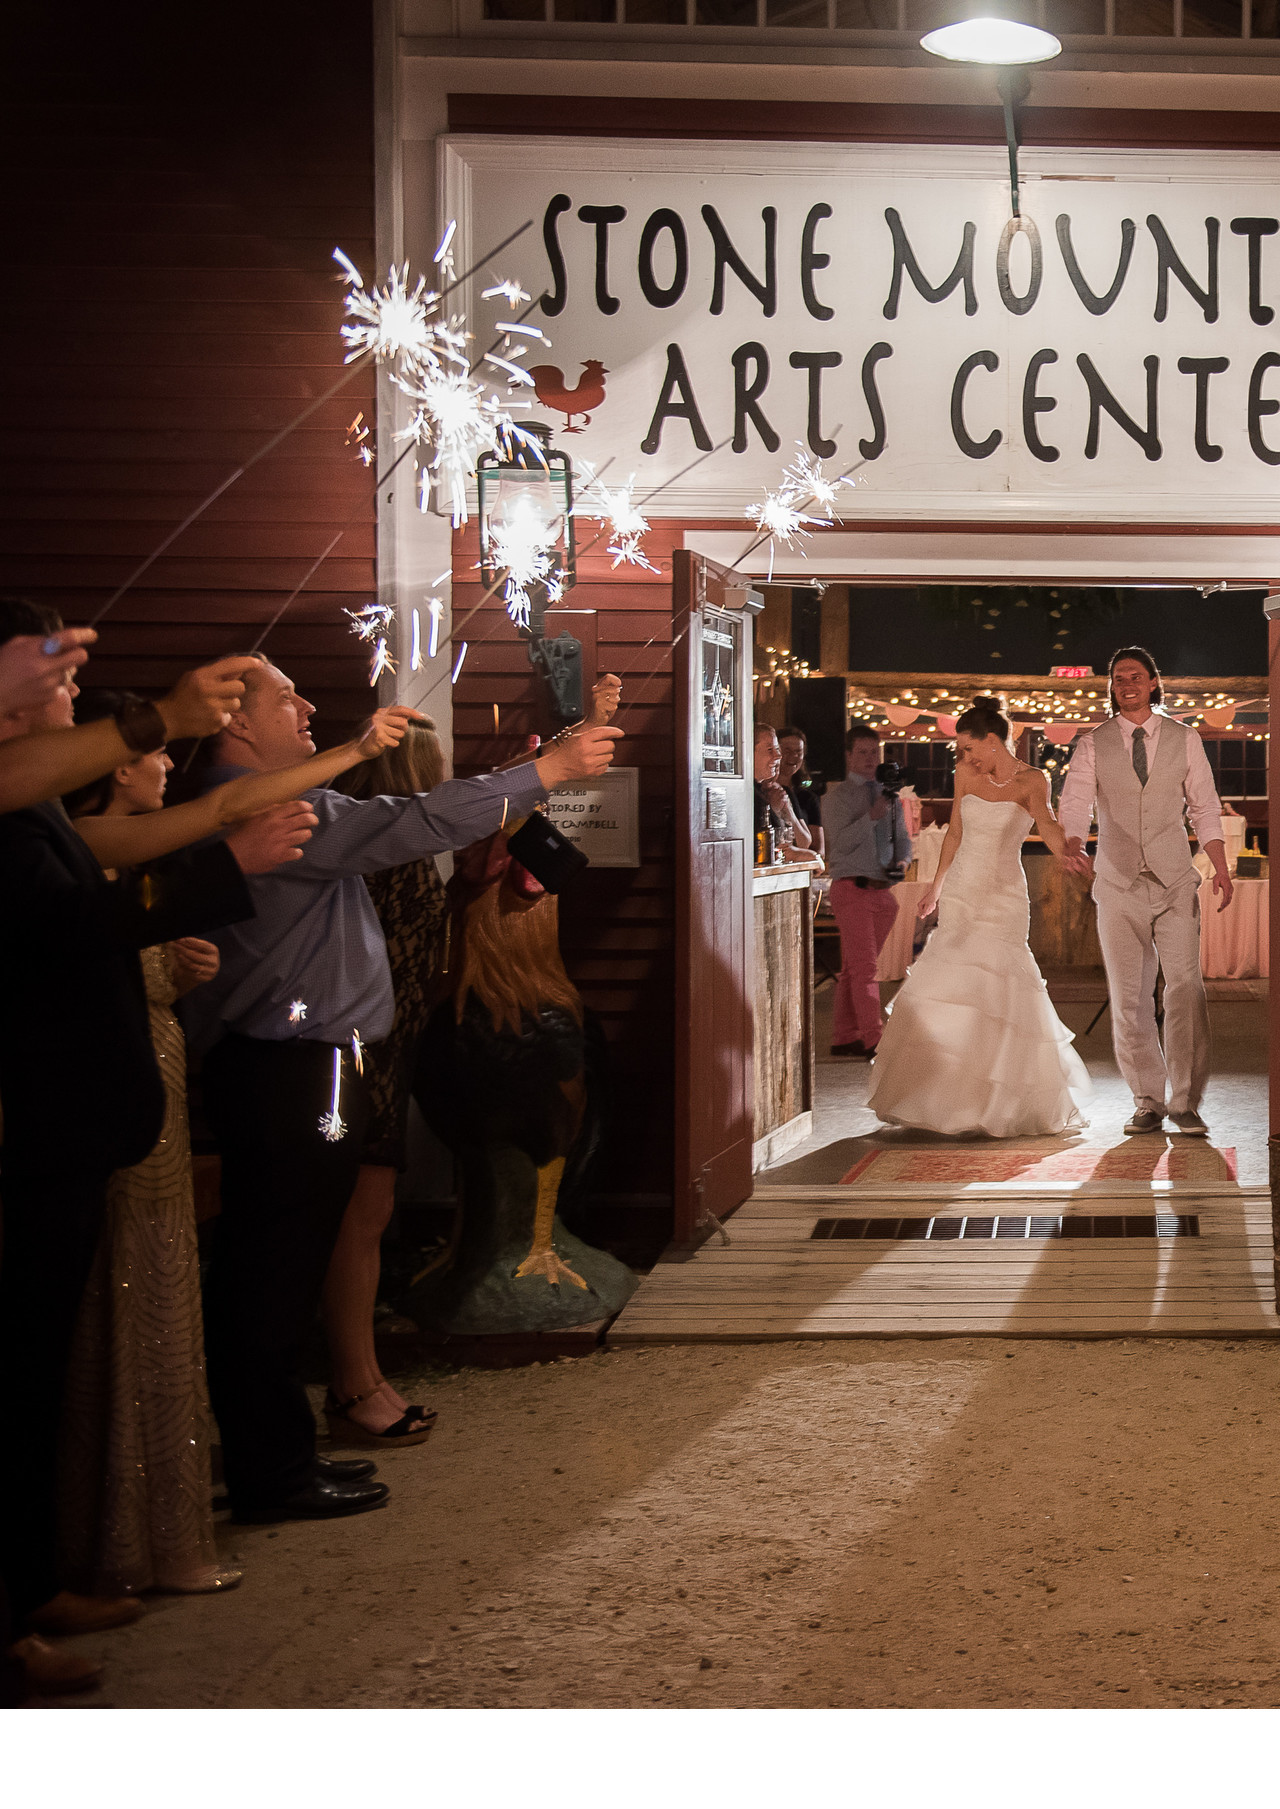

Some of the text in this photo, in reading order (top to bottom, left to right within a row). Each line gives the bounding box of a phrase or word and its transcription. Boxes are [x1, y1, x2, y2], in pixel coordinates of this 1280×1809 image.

[540, 193, 834, 321] STONE
[640, 341, 893, 461] ARTS
[562, 820, 618, 829] CAMPBELL
[589, 804, 601, 813] BY
